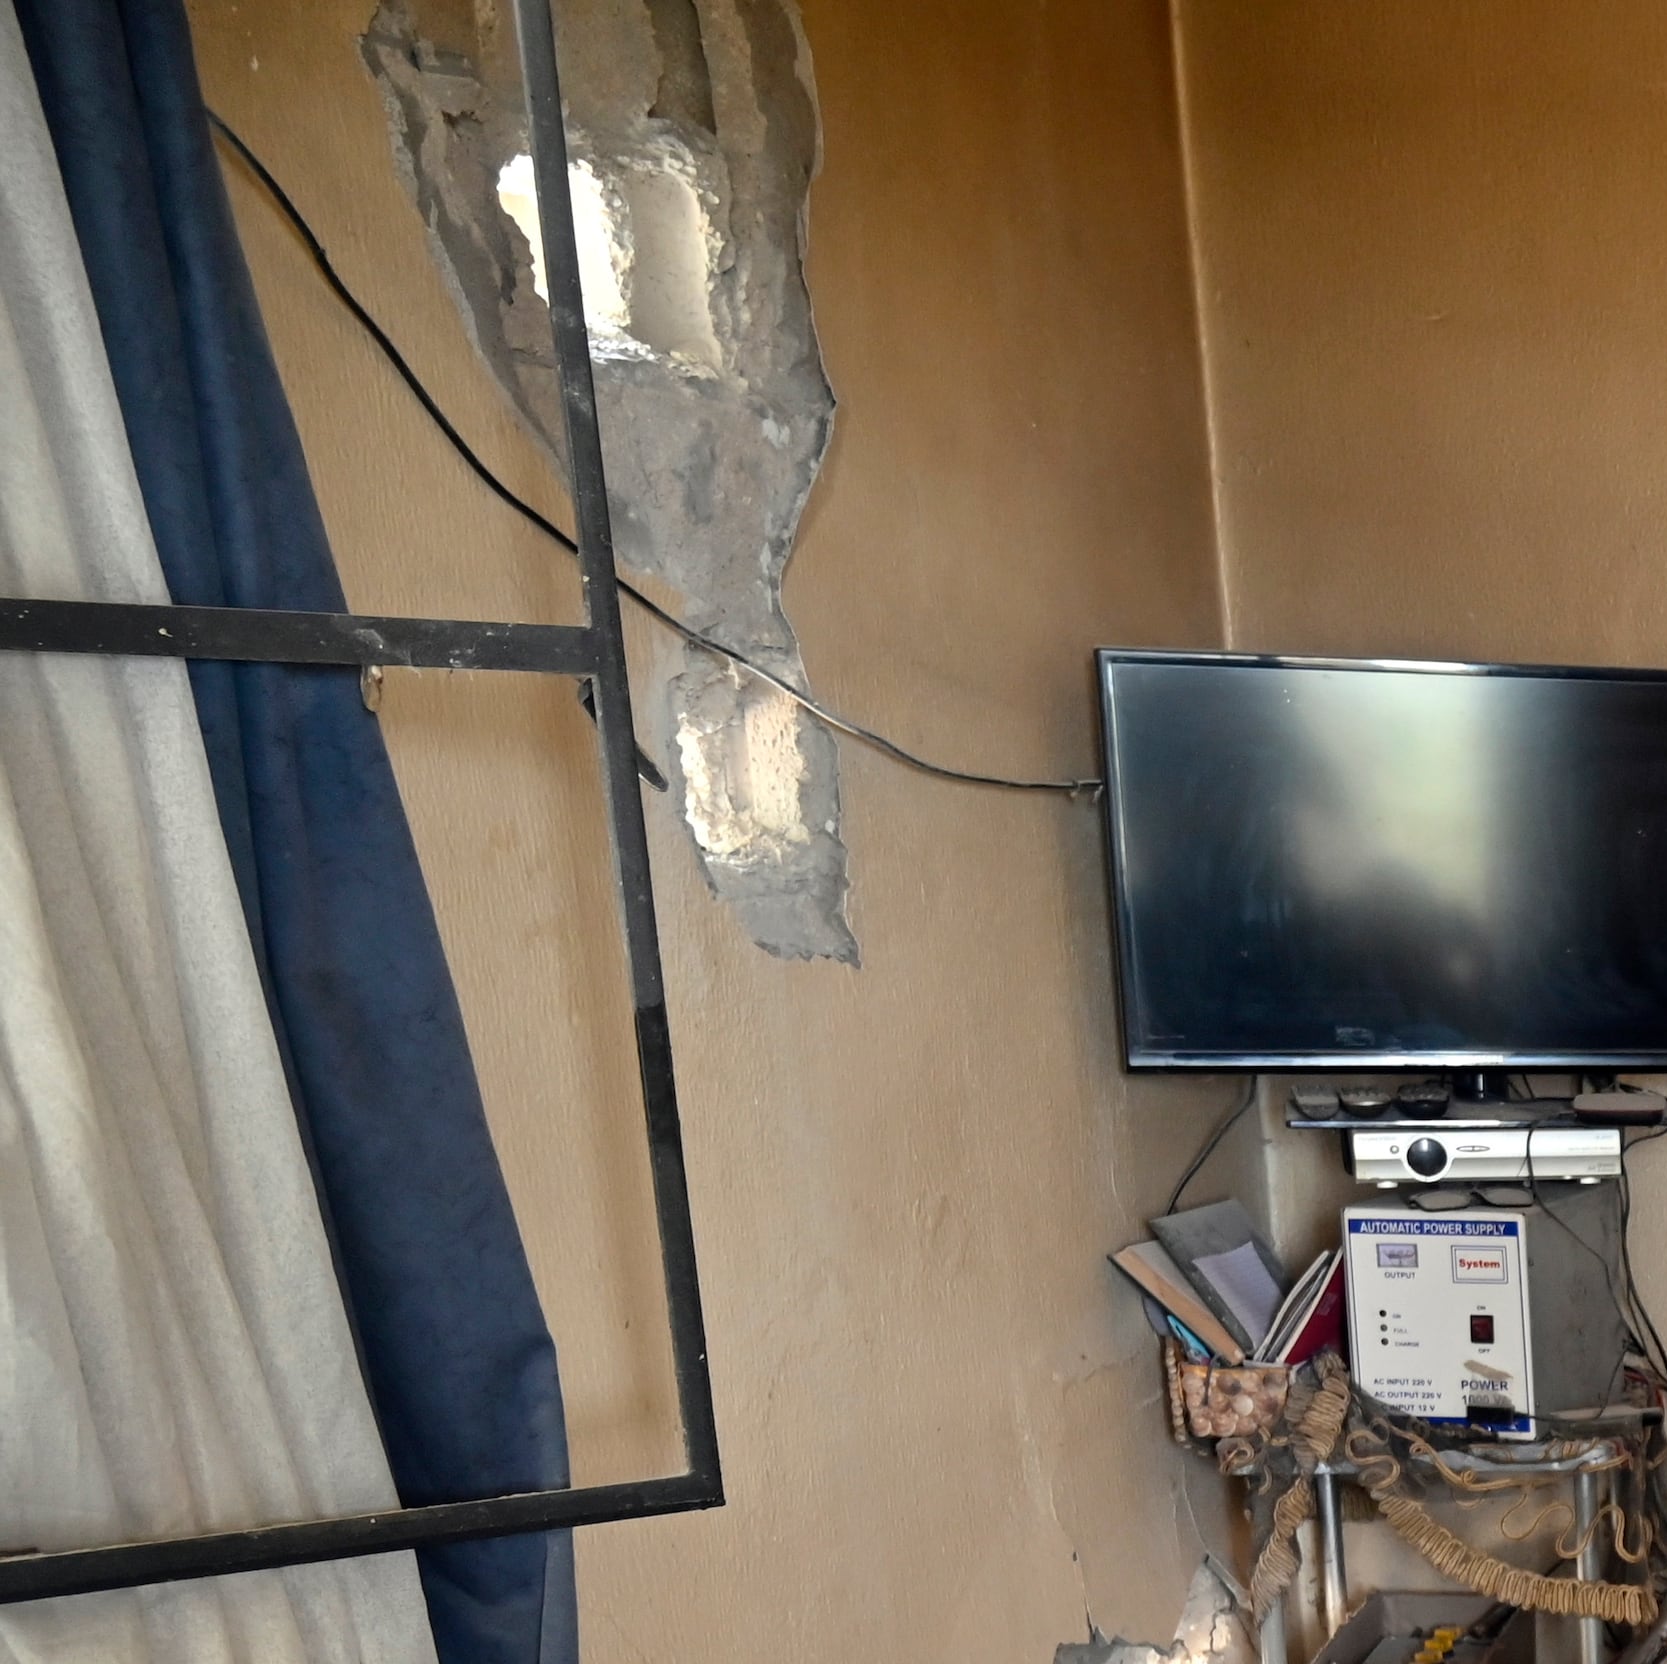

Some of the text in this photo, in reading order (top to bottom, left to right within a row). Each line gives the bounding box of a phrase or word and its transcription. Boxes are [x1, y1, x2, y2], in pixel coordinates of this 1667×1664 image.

[1360, 1221, 1506, 1236] AUTOMATIC POWER SUPPLY
[1459, 1258, 1500, 1270] System
[1384, 1271, 1416, 1280] OUTPUT
[1373, 1378, 1433, 1387] AC INPUT 220 V
[1461, 1379, 1509, 1391] POWER
[1374, 1391, 1442, 1400] AC OUTPUT 220 V
[1418, 1404, 1428, 1412] 12
[1429, 1404, 1436, 1412] V
